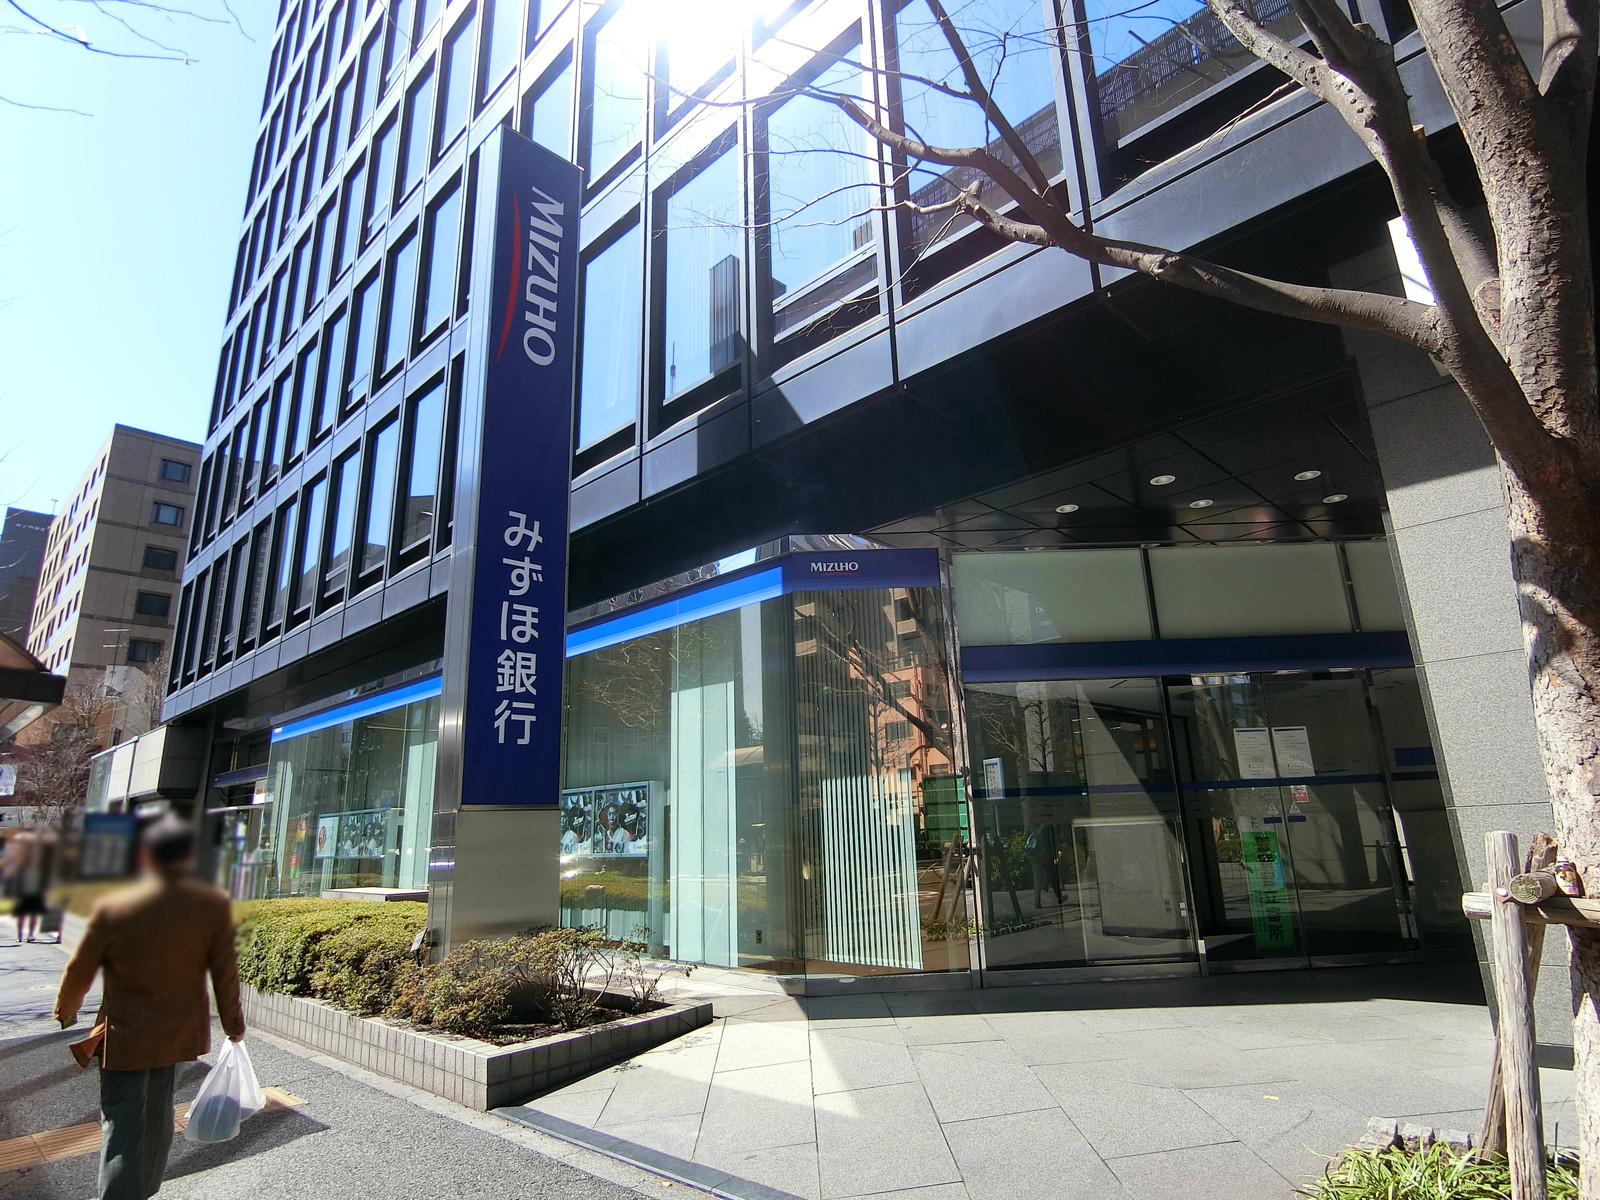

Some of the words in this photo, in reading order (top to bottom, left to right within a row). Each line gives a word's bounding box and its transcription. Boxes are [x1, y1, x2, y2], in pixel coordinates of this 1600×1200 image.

[523, 186, 564, 366] MIZUHO
[494, 510, 543, 745] みずほ銀行
[810, 562, 859, 572] MIZUHO
